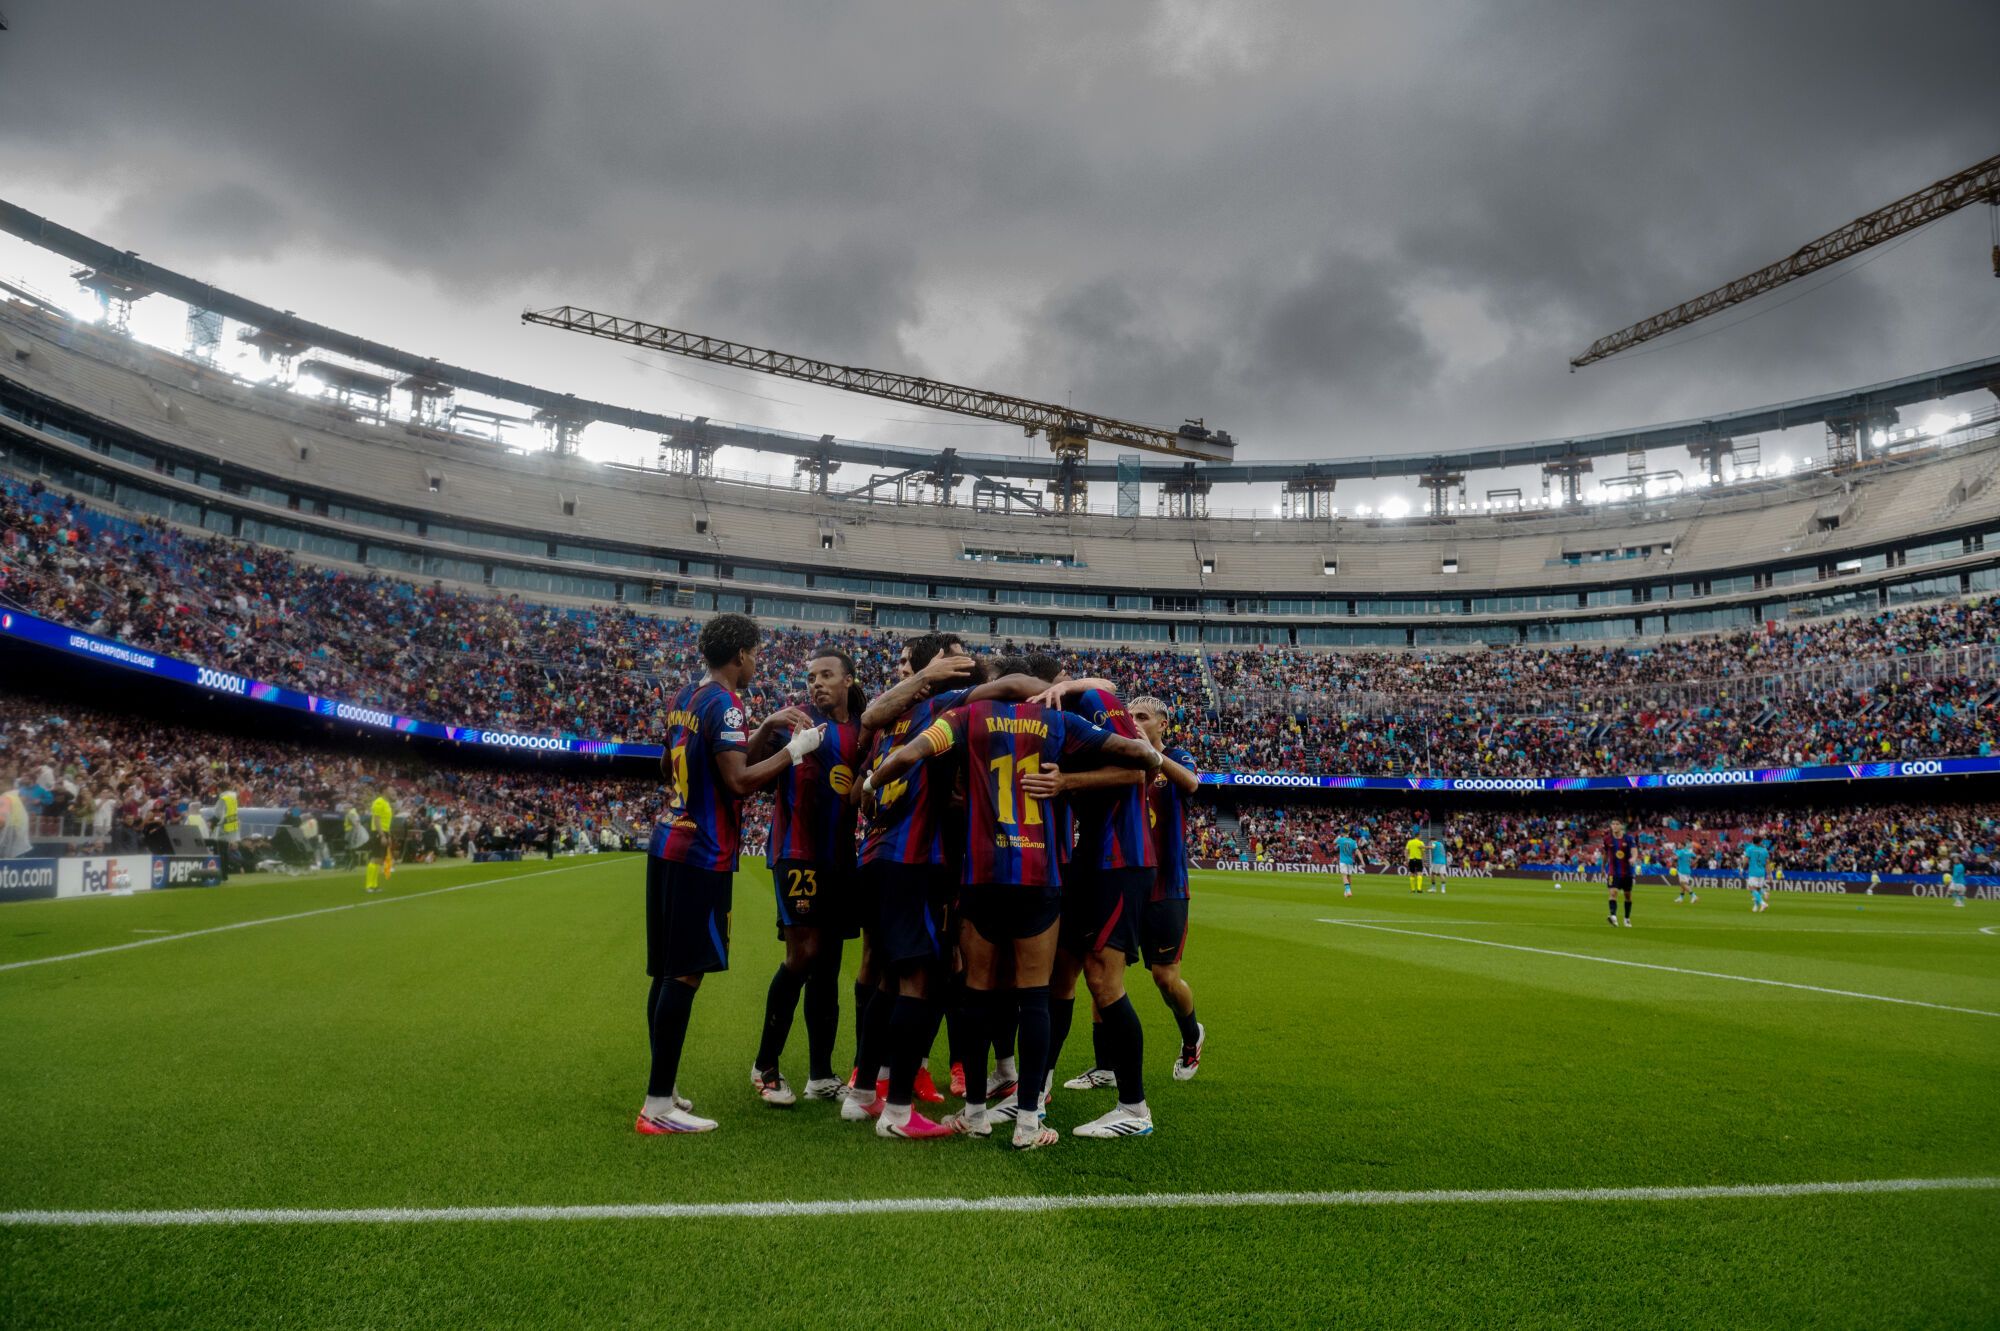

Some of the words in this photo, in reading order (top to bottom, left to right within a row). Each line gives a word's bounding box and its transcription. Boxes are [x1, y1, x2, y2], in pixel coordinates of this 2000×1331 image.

[70, 635, 88, 650] UEFA
[90, 640, 130, 662] CHAMPIONS
[130, 652, 156, 668] LEAGUE
[985, 716, 1048, 738] RAPHINHA
[482, 732, 570, 750] GOOOOOOOL!
[1234, 774, 1321, 786] GOOOOOOOL!
[1454, 778, 1546, 790] GOOOOOOOL!
[1667, 770, 1754, 786] GOOOOOOOL!
[990, 752, 1043, 825] 11
[1216, 860, 1250, 871] OVER
[1254, 862, 1273, 872] 160
[1276, 862, 1366, 874] DESTINATINS
[788, 868, 817, 896] 23
[1552, 872, 1588, 882] QATAR
[1722, 878, 1740, 890] 160
